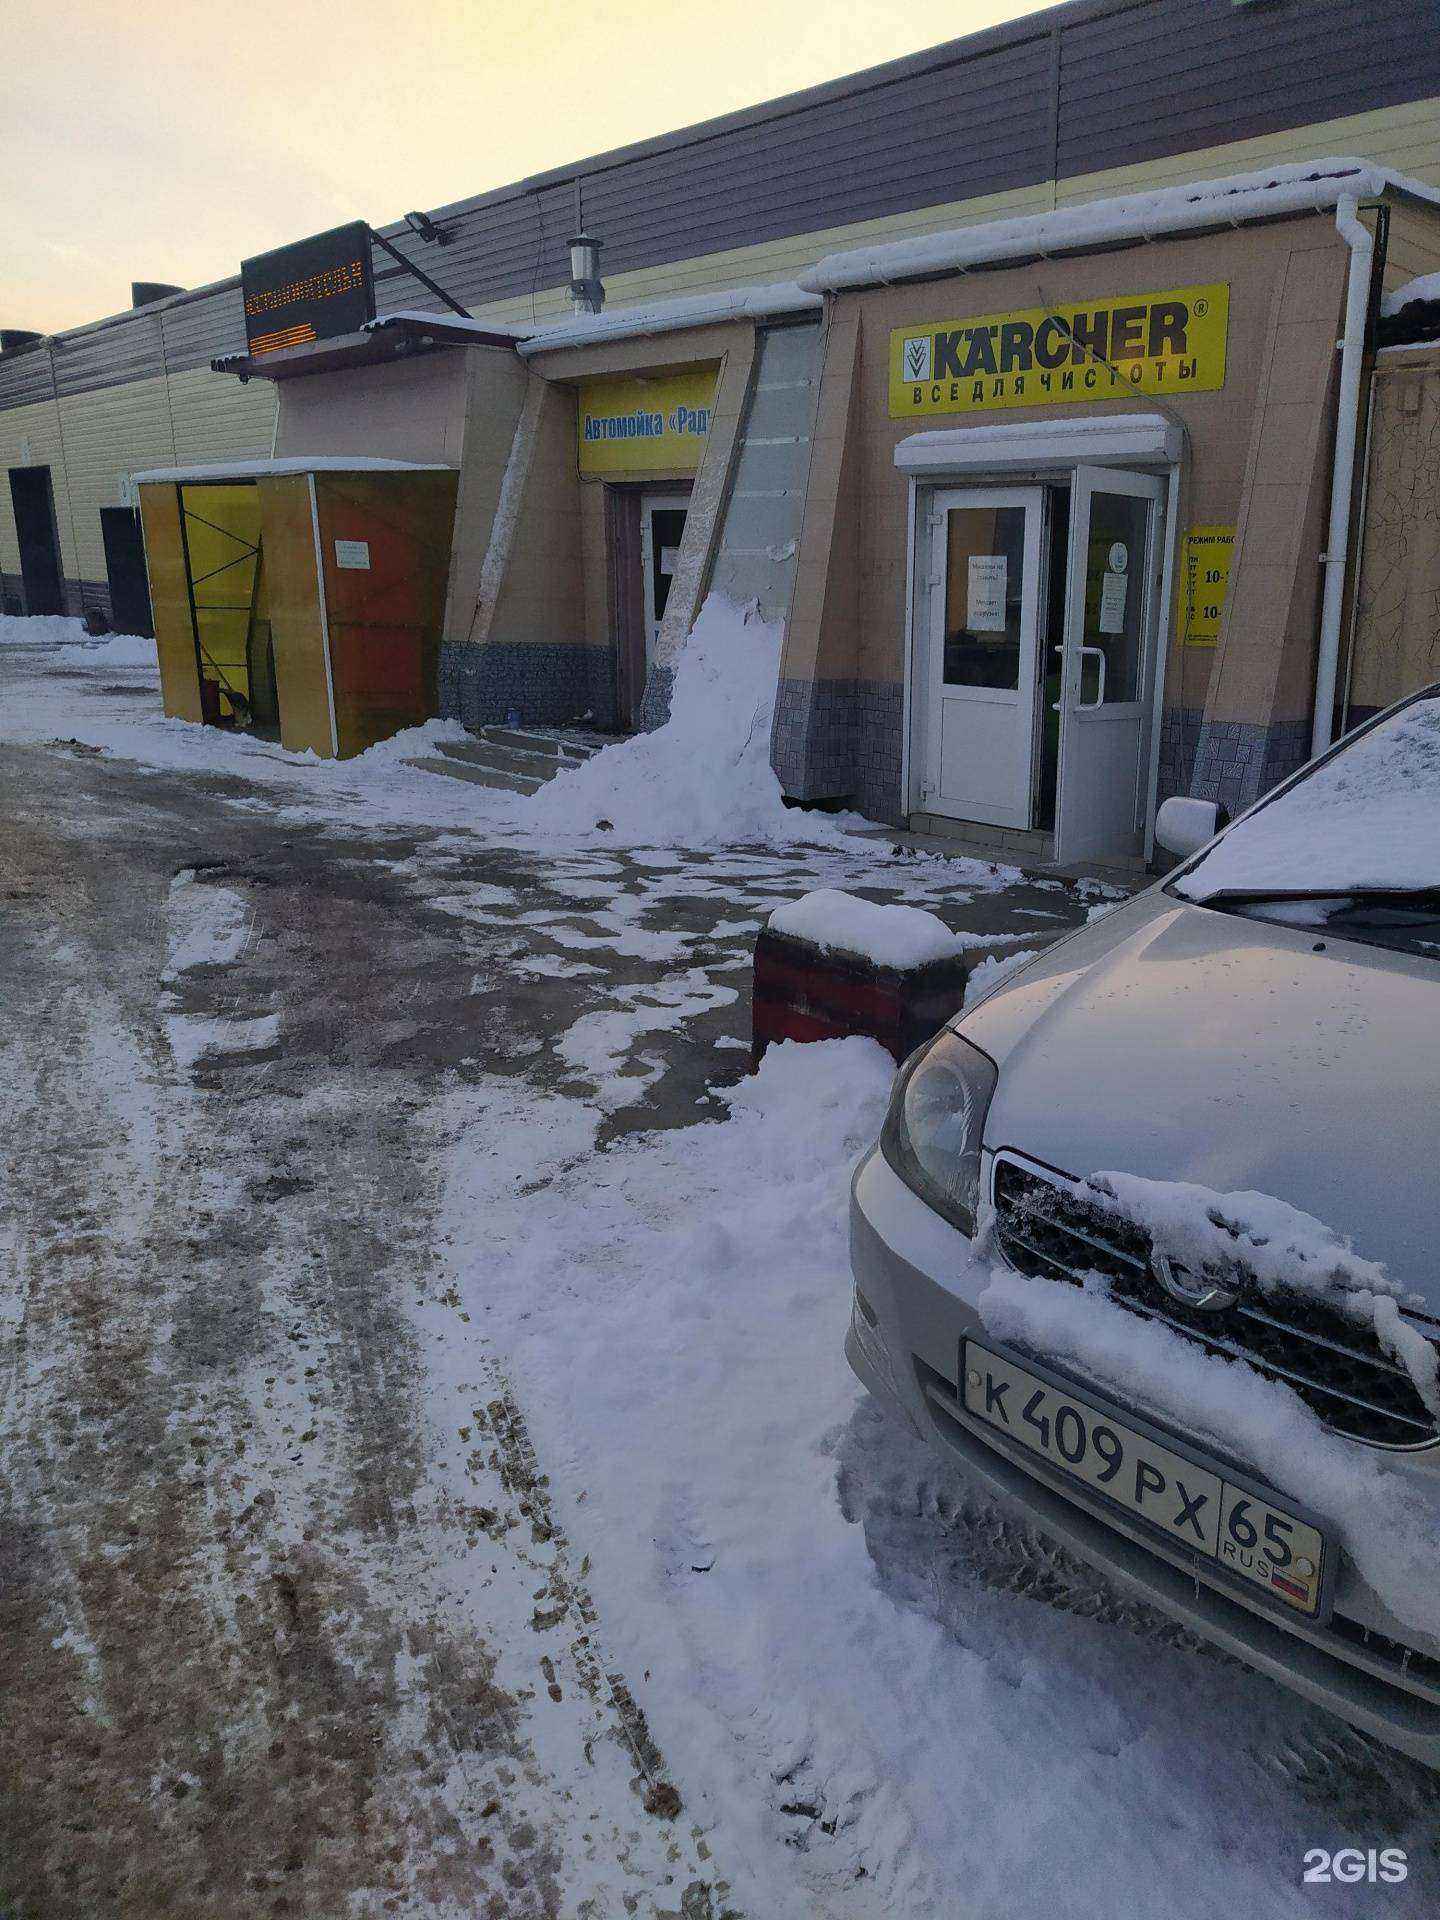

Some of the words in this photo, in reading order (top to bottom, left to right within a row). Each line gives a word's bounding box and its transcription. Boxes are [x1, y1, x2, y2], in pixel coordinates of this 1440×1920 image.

[913, 382, 959, 405] ВСЕ
[972, 375, 1025, 402] ДЛЯ
[1040, 358, 1197, 392] ЧИСТОТЫ
[584, 409, 664, 441] Автомойка
[668, 404, 712, 436] «Рад
[1223, 1541, 1270, 1579] RUS
